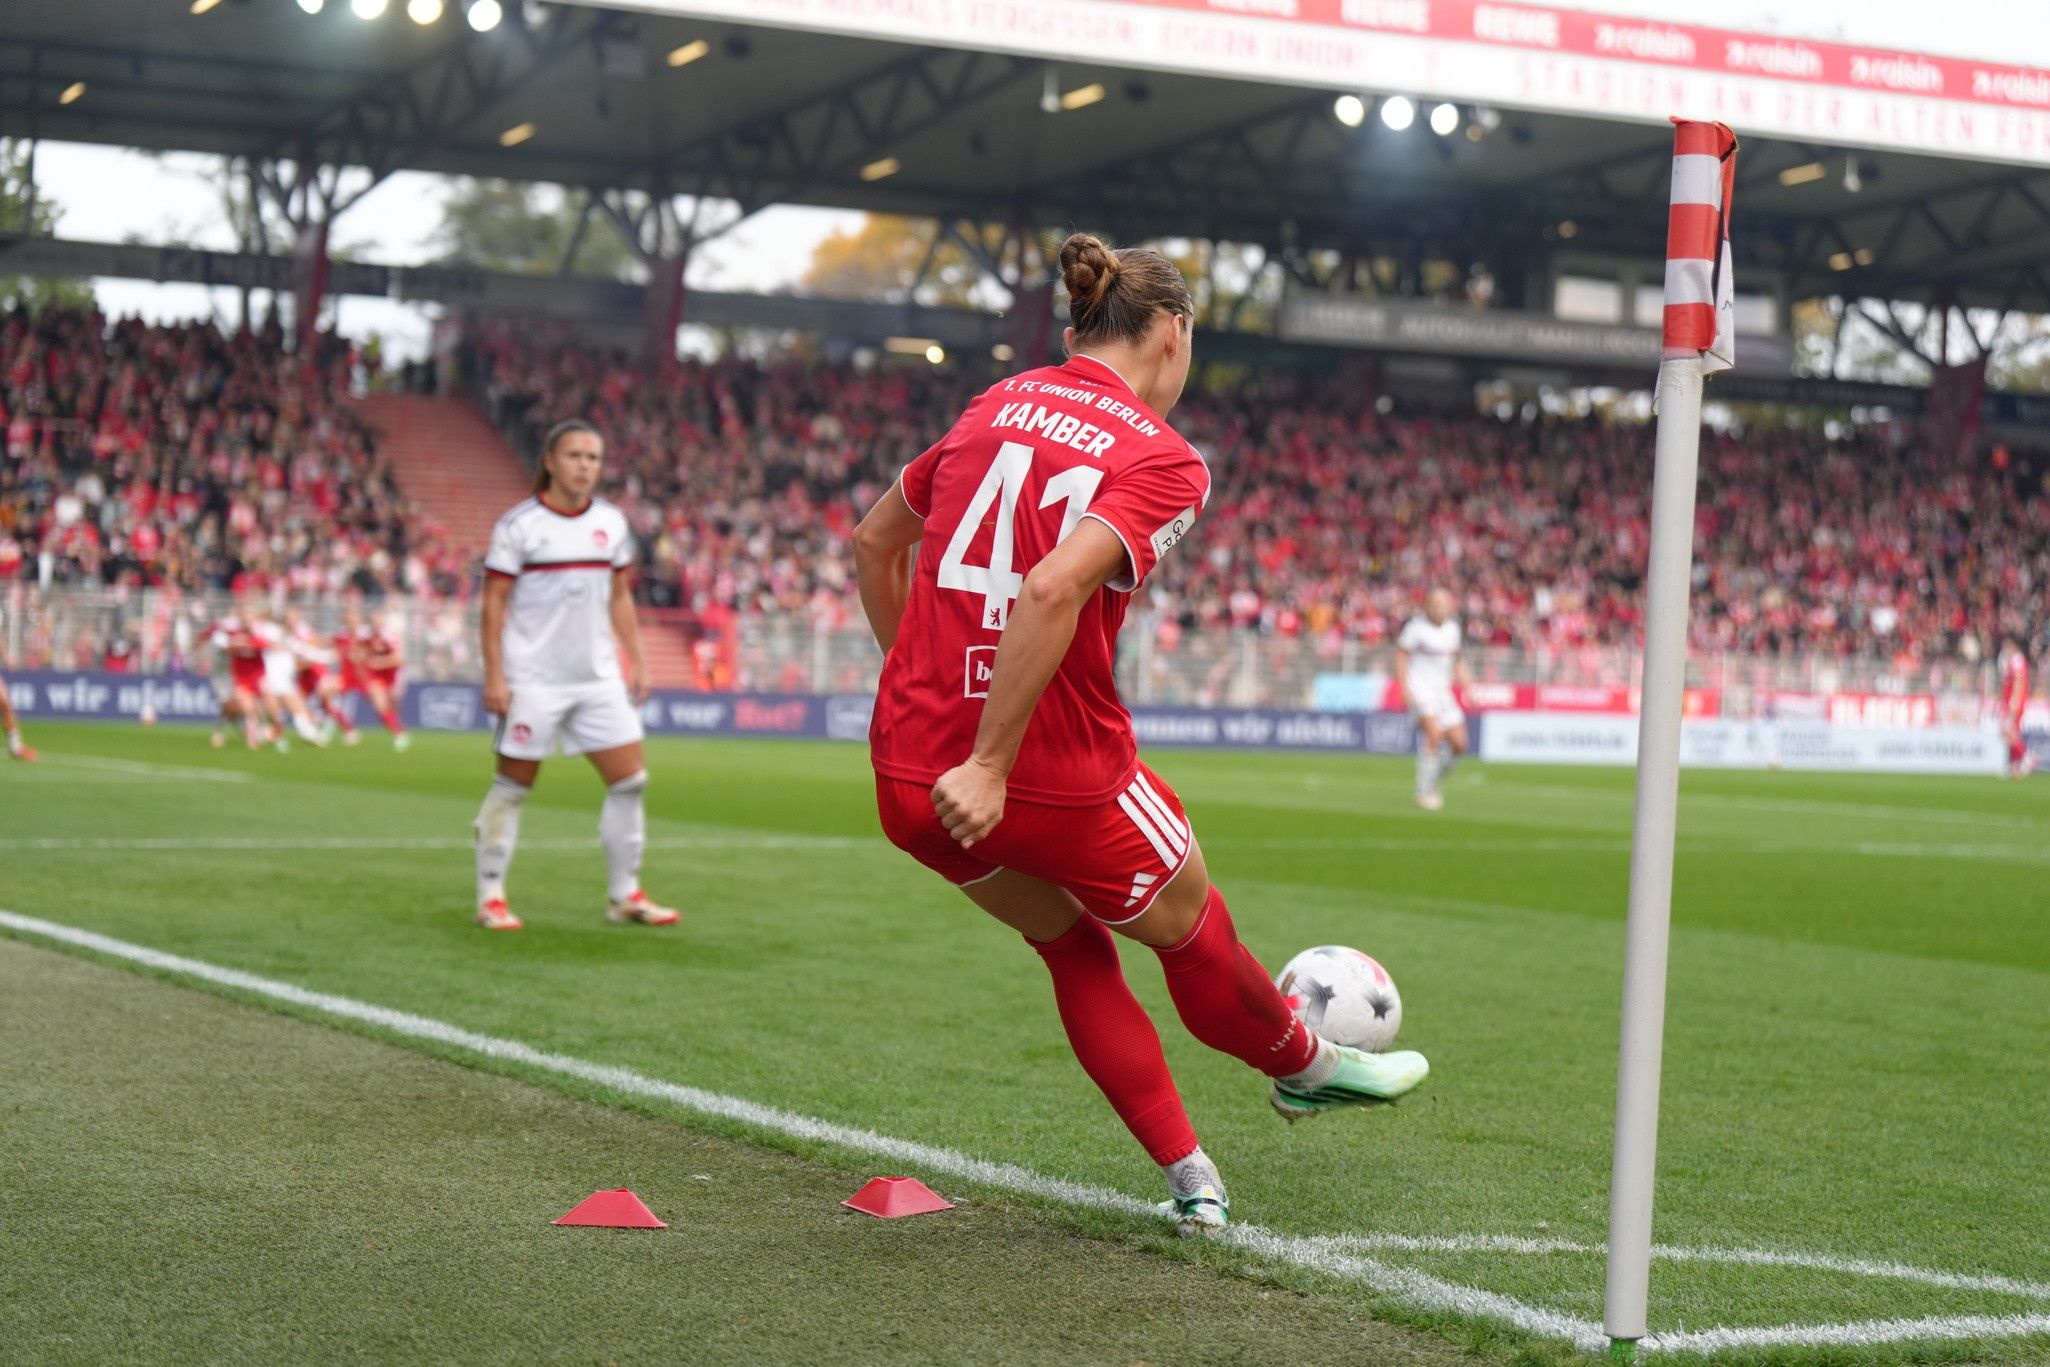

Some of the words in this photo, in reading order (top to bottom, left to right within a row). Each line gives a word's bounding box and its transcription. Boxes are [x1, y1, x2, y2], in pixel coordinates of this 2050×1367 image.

[990, 402, 1116, 459] KAMBER
[1003, 379, 1014, 392] 1.
[1018, 380, 1041, 392] FC
[1039, 382, 1098, 405] UNION
[1094, 396, 1161, 438] BERLIN
[937, 440, 1104, 631] 41
